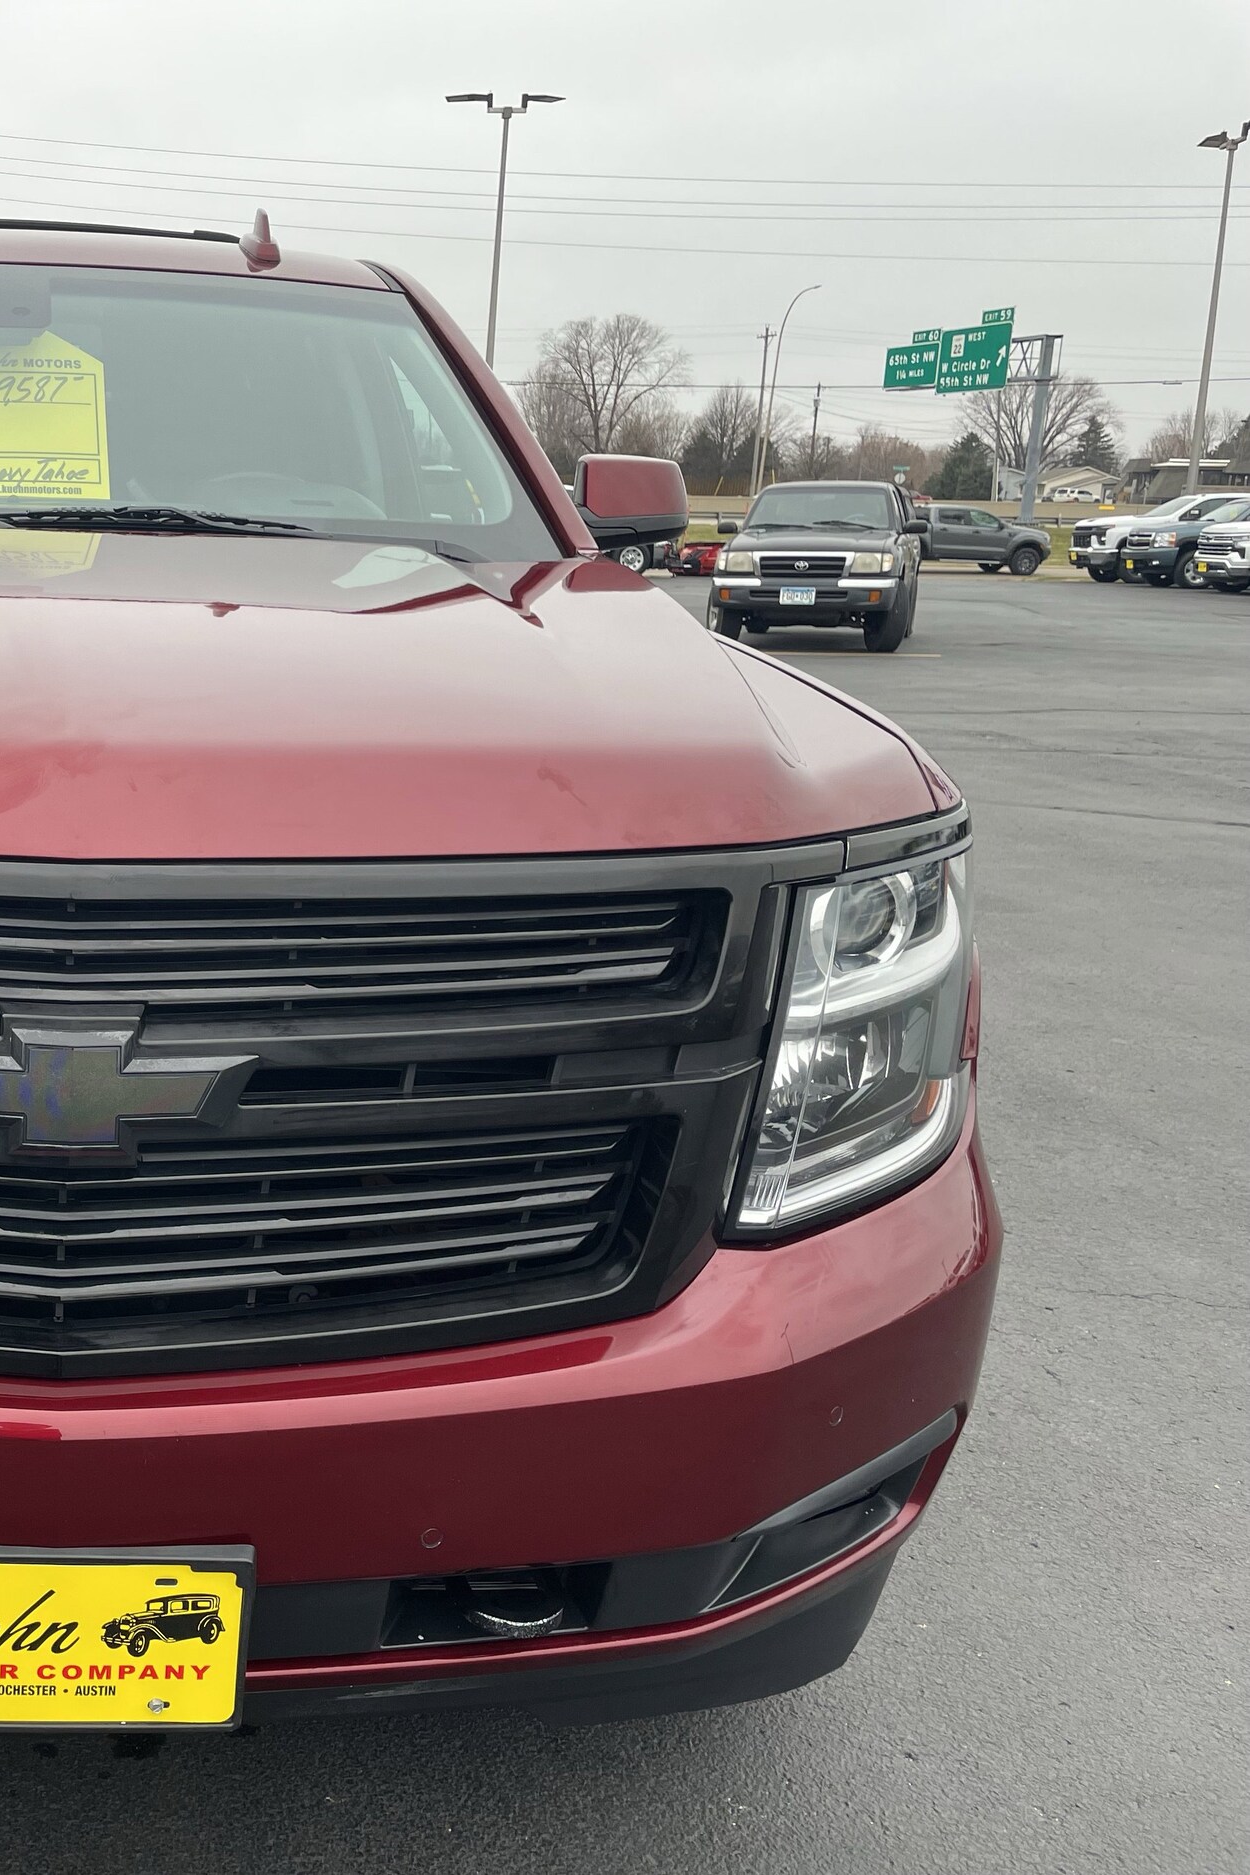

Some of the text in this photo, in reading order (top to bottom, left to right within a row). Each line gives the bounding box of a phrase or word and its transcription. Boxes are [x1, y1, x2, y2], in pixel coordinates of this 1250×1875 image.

[984, 309, 1012, 321] EXIT 59
[914, 331, 939, 342] EXIT 60
[968, 332, 986, 341] WEST
[953, 344, 962, 354] 22
[23, 358, 82, 369] MOTORS
[889, 351, 935, 366] 65th St NW
[941, 359, 991, 373] W Circle Dr
[909, 369, 924, 377] MILES
[939, 374, 990, 389] 55th St NW
[33, 458, 90, 483] Tahoe
[37, 1664, 212, 1680] COMPANY
[74, 1684, 116, 1697] AUSTIN
